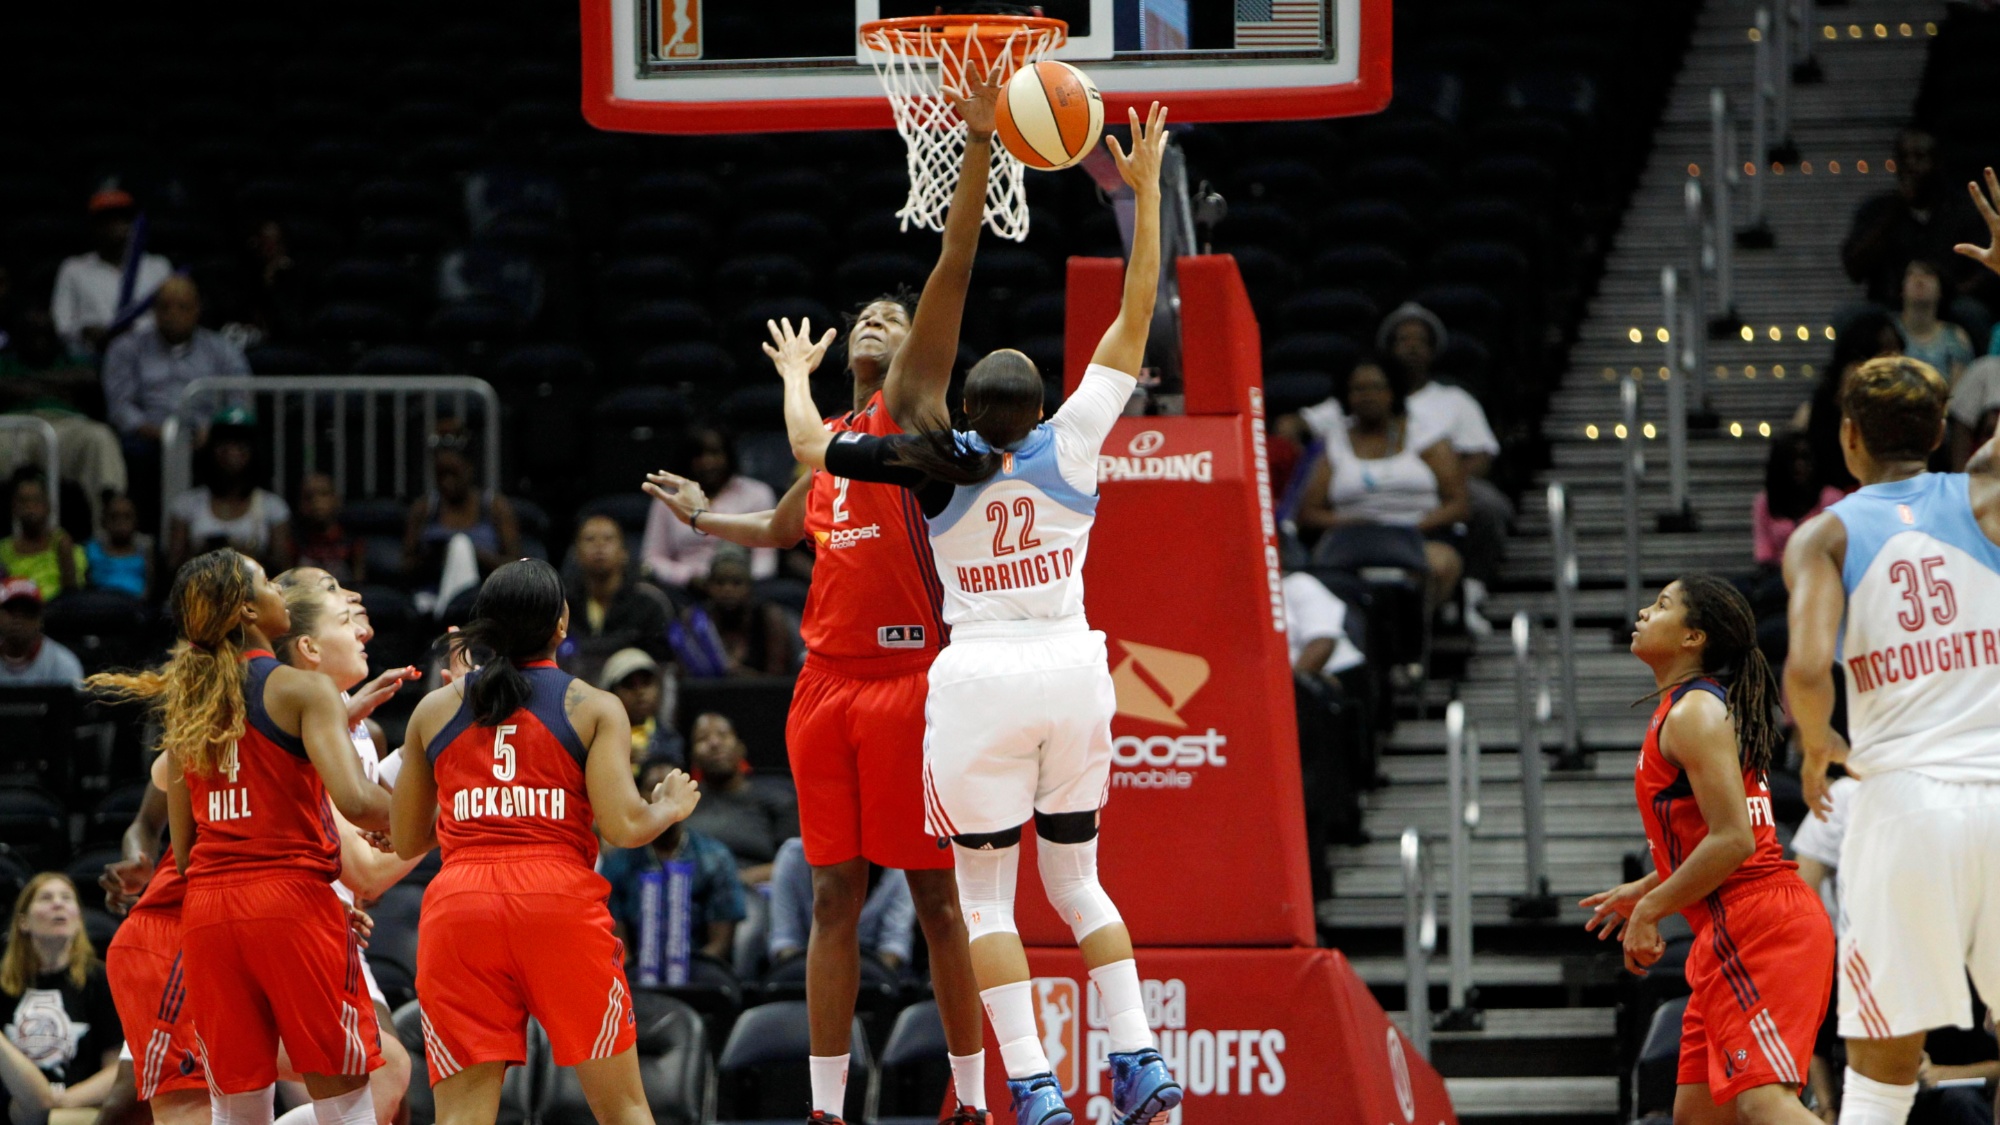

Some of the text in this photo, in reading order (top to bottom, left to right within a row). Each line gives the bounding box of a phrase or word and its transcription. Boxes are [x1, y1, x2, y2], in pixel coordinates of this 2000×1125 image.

[1098, 450, 1213, 484] PALDING
[833, 476, 849, 523] 2
[830, 540, 856, 549] mobile
[831, 523, 880, 543] boost
[986, 496, 1041, 557] 22
[1889, 555, 1957, 632] 35
[1848, 629, 2000, 693] MCCOUGHTR
[219, 738, 241, 783] 4
[492, 724, 517, 782] 5
[1112, 727, 1227, 767] oost
[1112, 768, 1193, 789] mobile
[208, 787, 252, 822] HILL
[1087, 1029, 1287, 1095] PYOFFS
